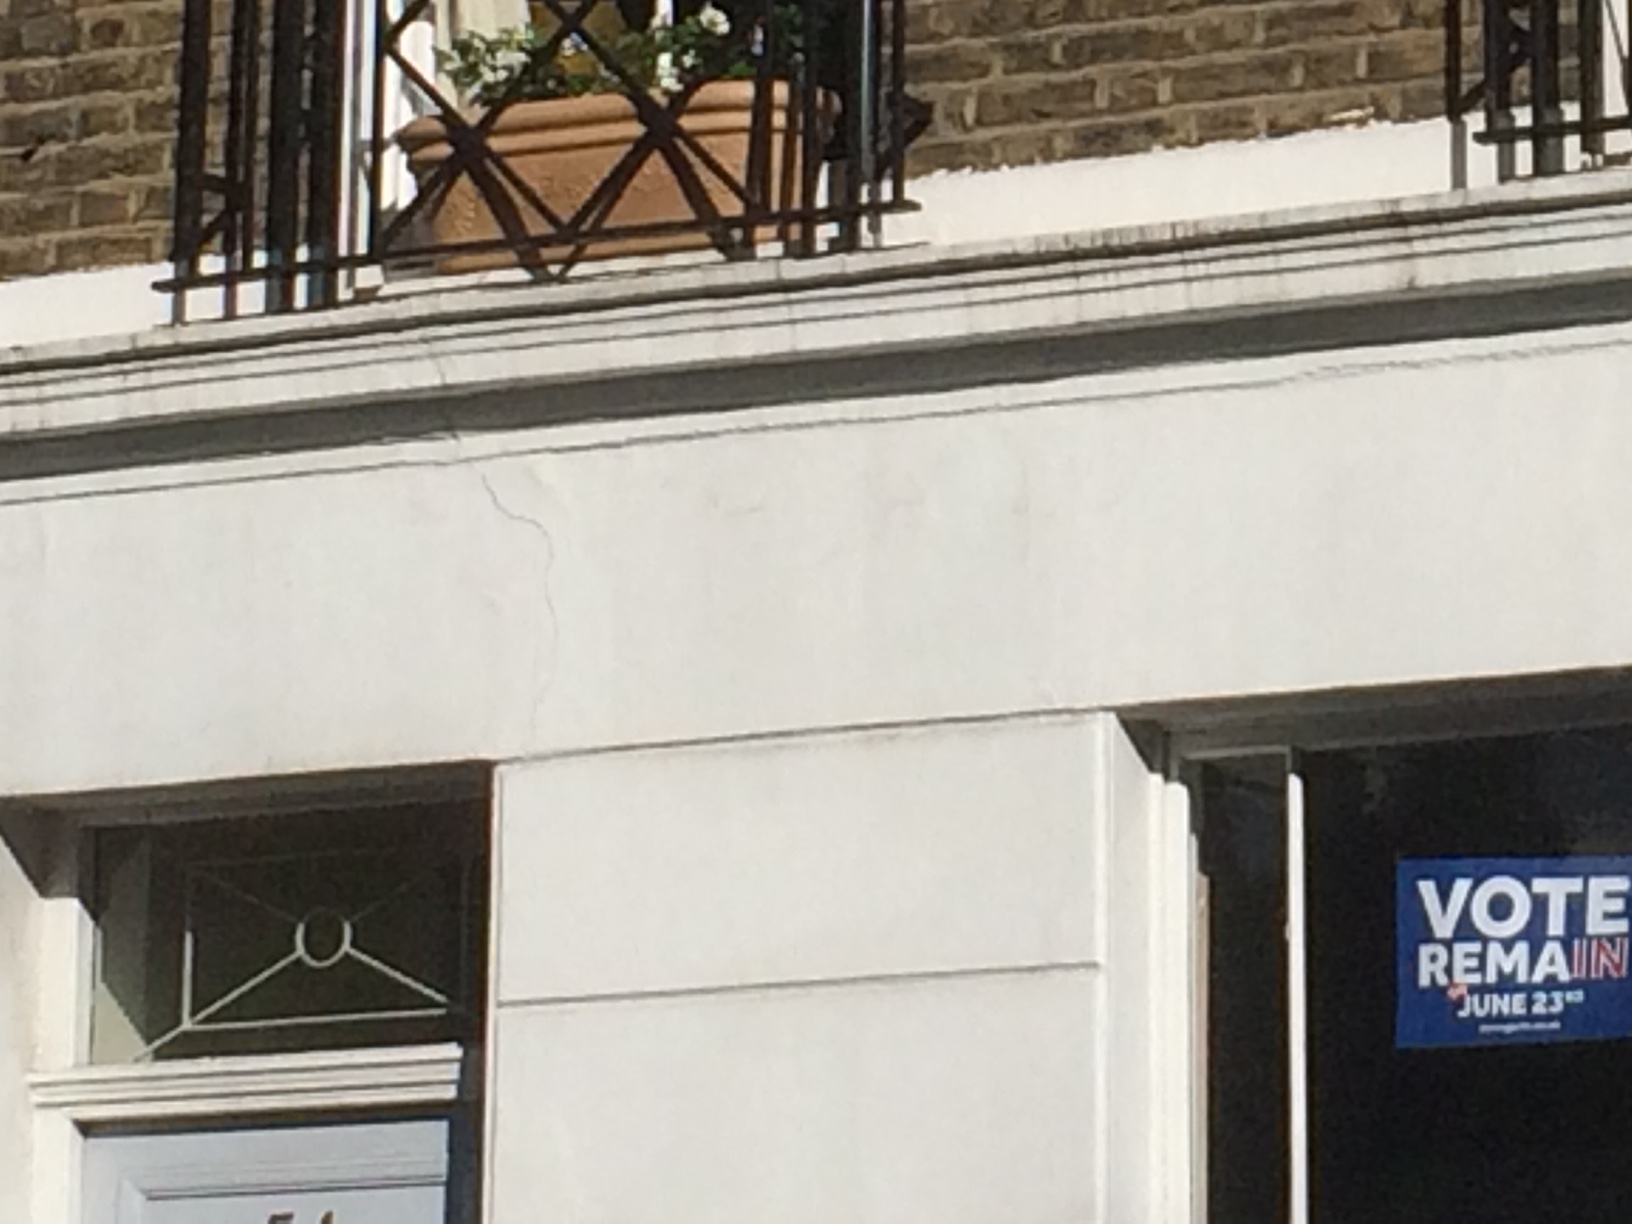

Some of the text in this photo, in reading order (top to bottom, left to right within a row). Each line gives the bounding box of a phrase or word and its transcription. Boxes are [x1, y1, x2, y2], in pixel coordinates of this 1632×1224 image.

[1416, 875, 1632, 939] VOTE
[1417, 937, 1629, 989] REMAIN
[1457, 992, 1527, 1018] JUNE
